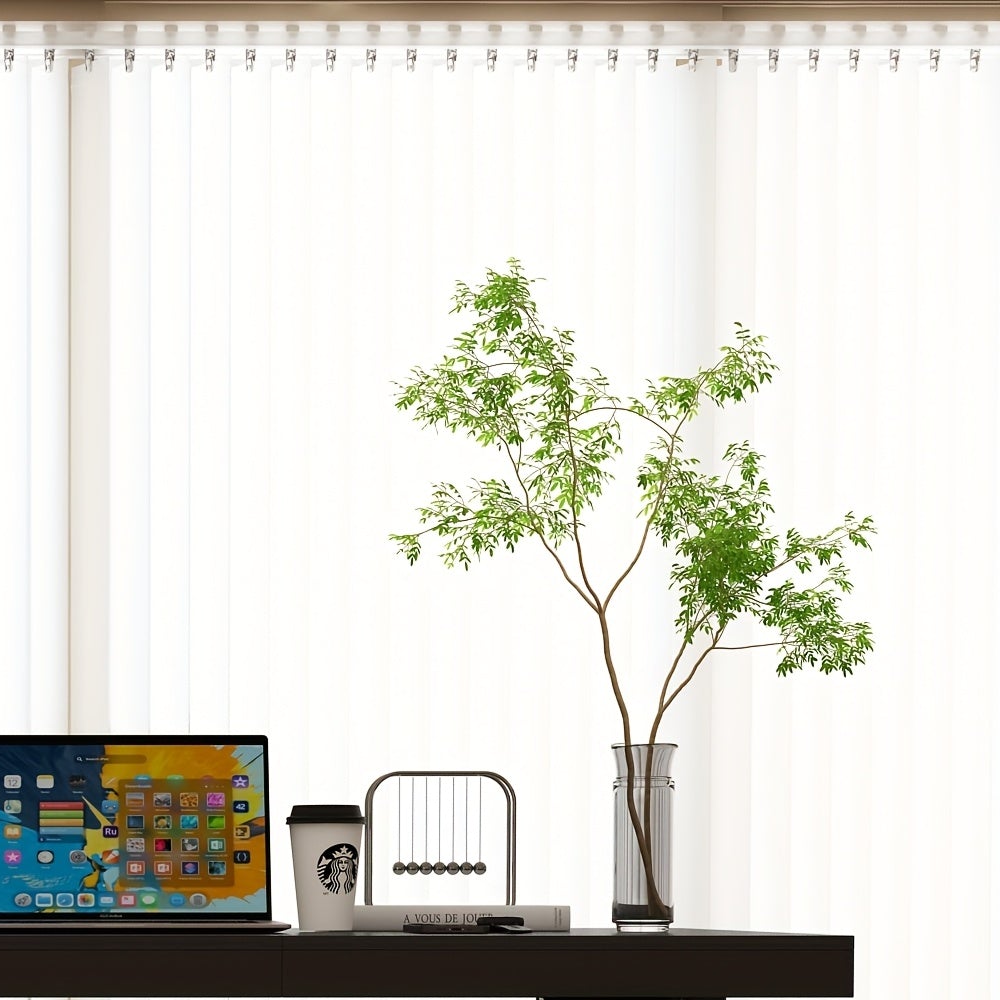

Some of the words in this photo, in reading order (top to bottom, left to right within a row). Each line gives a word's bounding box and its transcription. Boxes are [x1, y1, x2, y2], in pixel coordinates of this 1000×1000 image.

[104, 827, 117, 836] Ru
[403, 913, 410, 924] A
[414, 913, 441, 924] VOUS
[445, 913, 459, 924] DE
